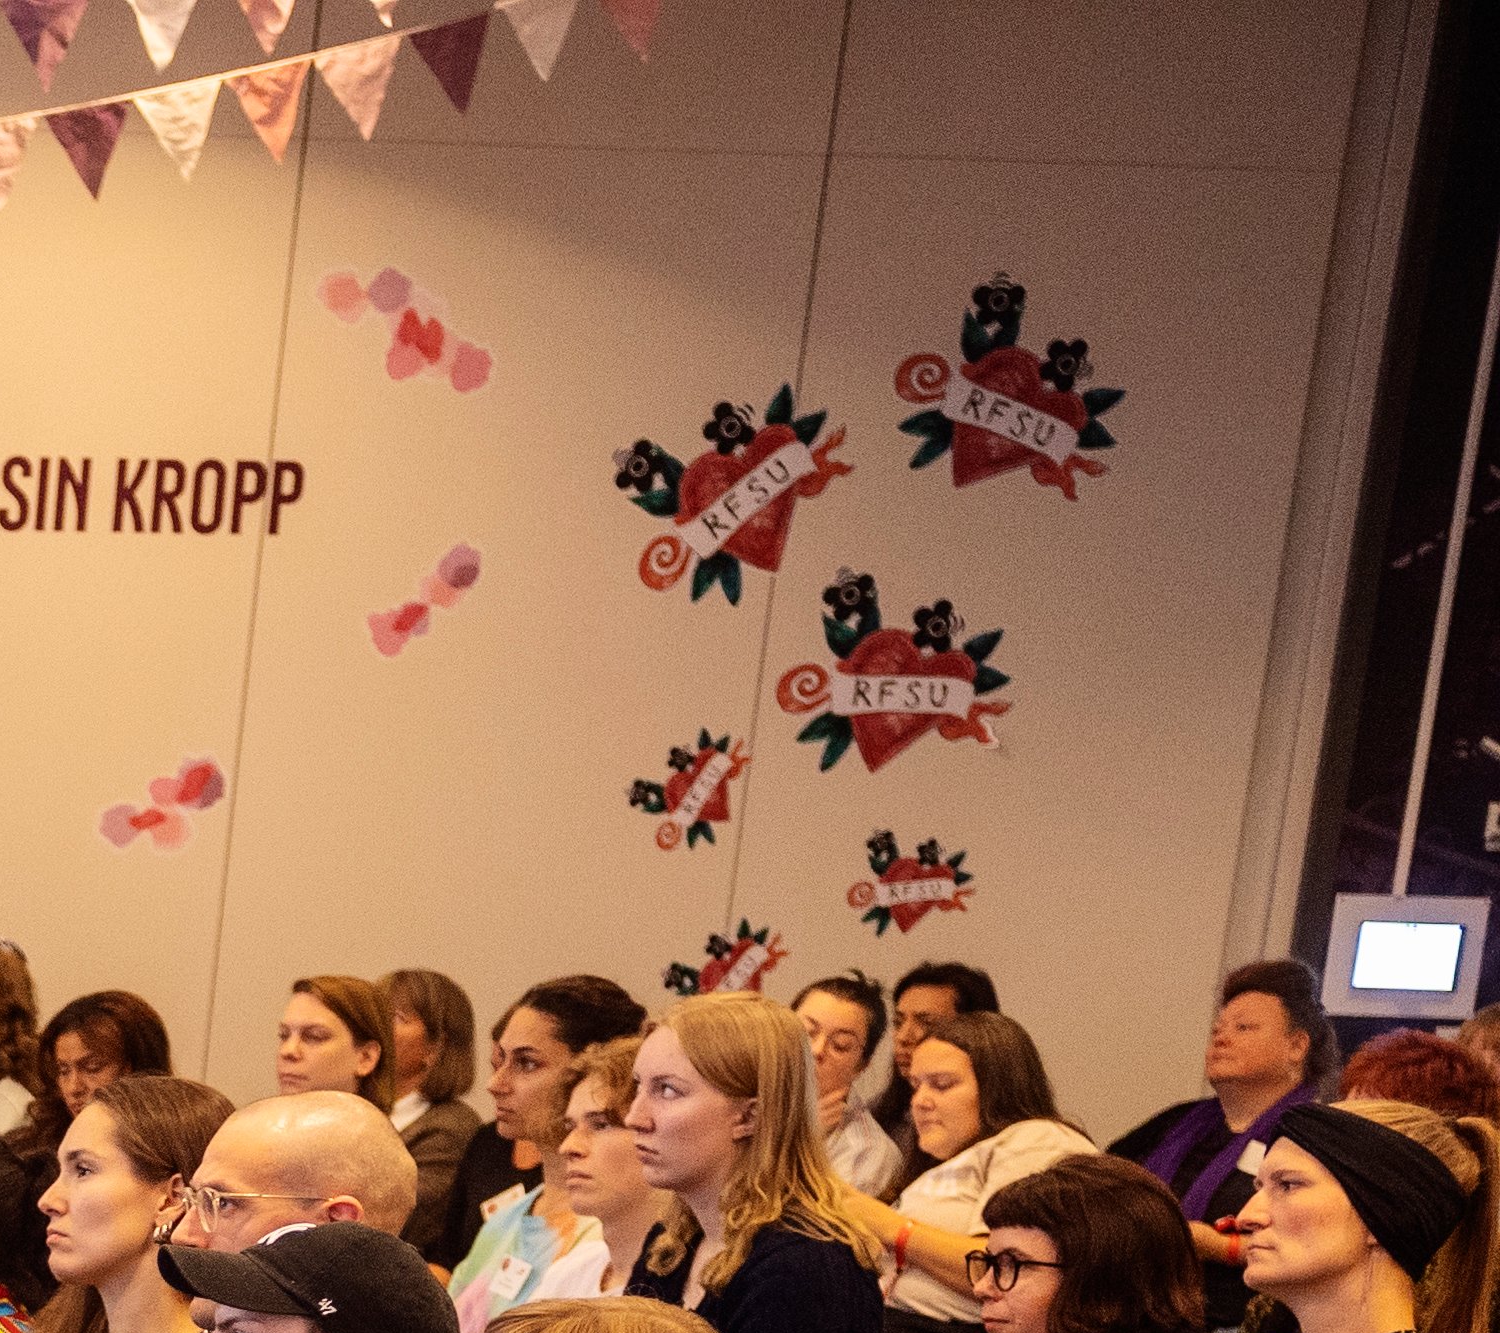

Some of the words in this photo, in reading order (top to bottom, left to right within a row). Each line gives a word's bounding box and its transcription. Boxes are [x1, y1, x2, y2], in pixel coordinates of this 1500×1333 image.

[961, 388, 1056, 446] RFSU
[111, 457, 306, 536] KROPP
[701, 460, 790, 539] RFSU
[851, 677, 950, 709] RFSU
